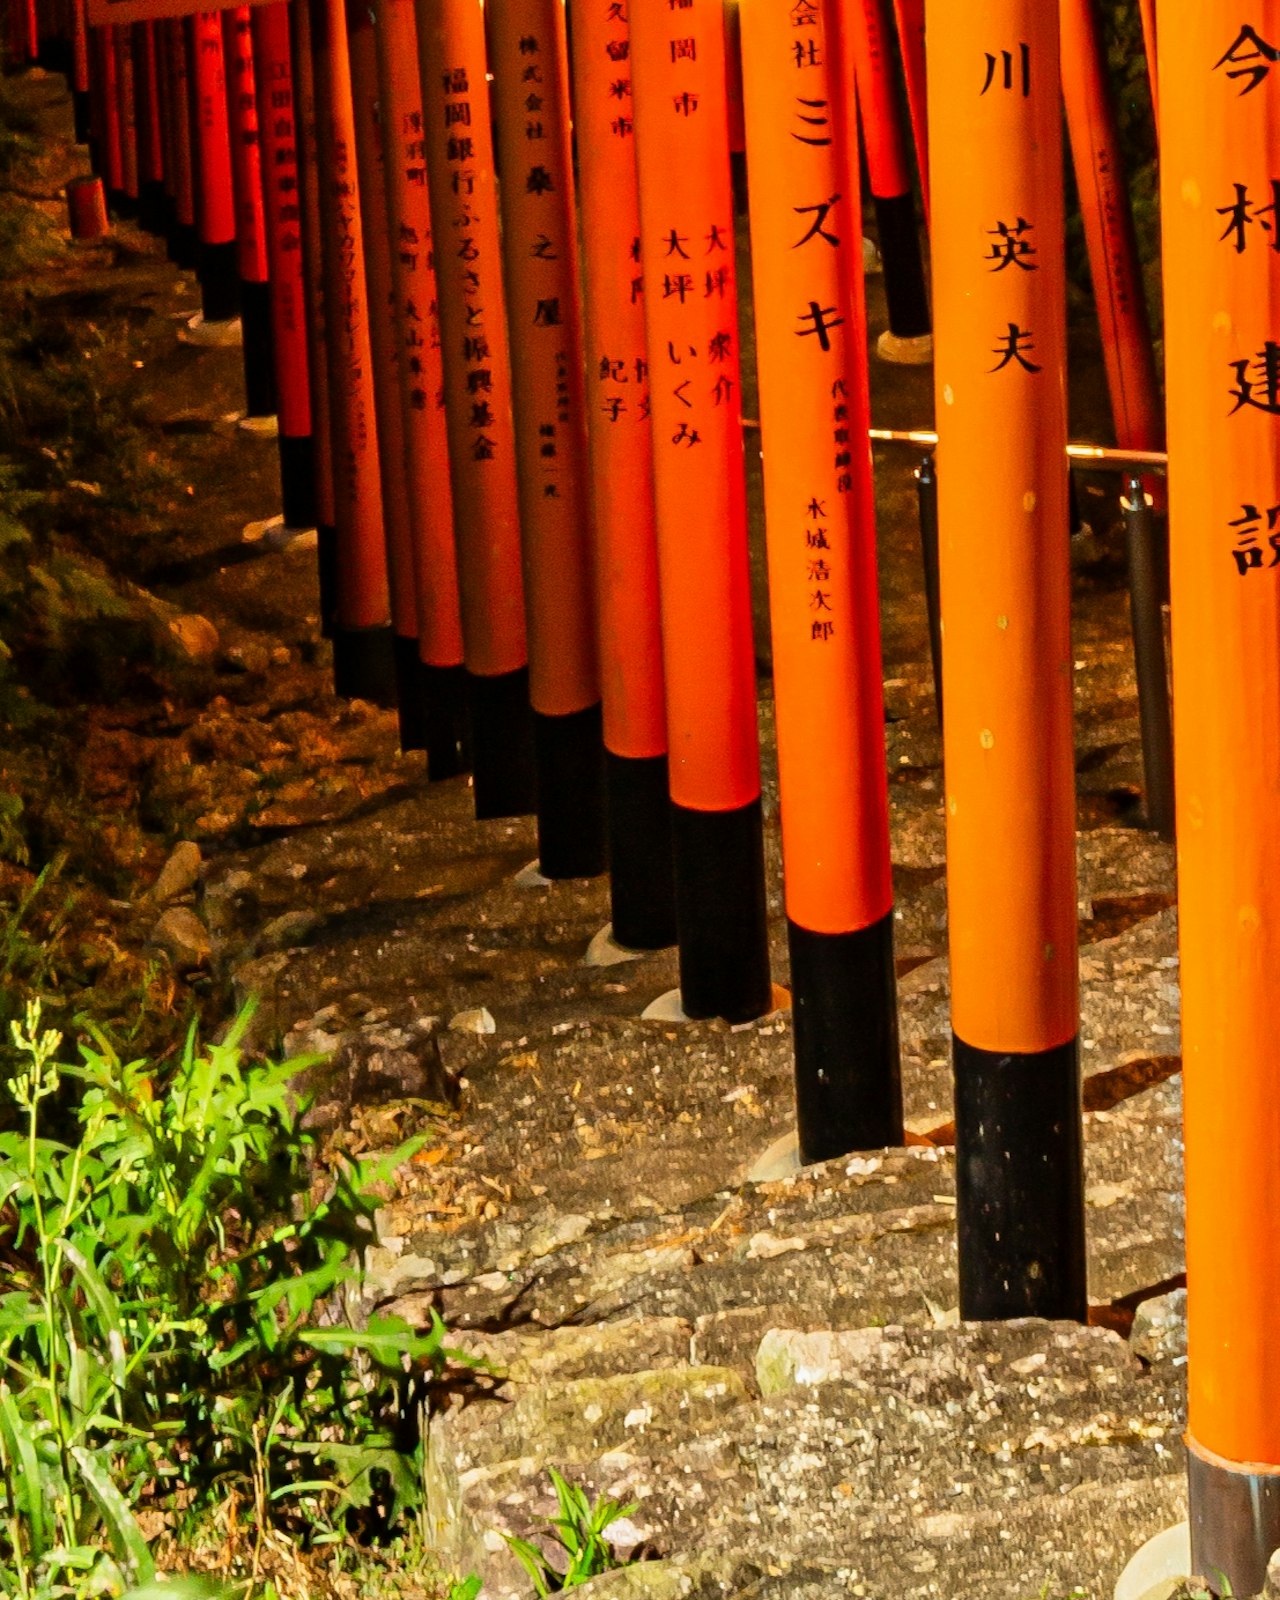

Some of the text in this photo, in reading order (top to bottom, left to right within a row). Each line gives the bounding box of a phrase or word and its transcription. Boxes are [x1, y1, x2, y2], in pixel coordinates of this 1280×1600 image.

[606, 3, 633, 138] 久留米市
[442, 67, 498, 462] 福岡銀行ふるさと振興基金
